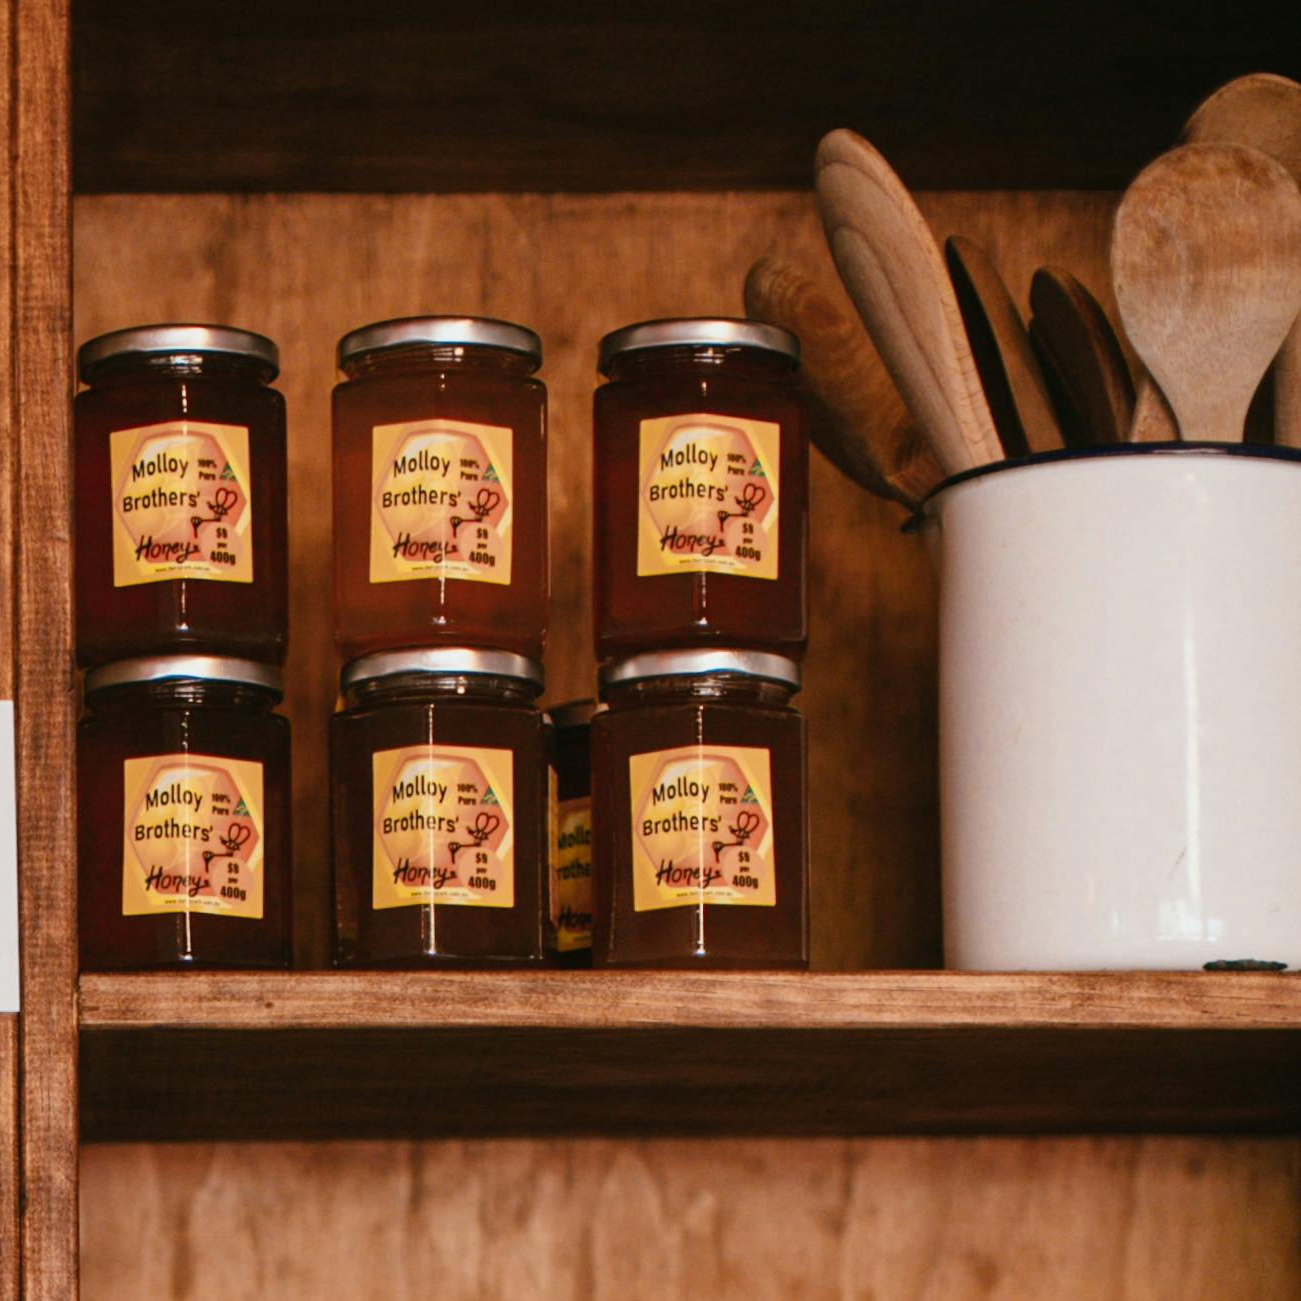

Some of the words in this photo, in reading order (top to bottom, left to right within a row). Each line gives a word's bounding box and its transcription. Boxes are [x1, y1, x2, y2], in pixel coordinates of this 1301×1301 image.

[132, 453, 189, 482] Molloy
[394, 450, 450, 478] Molloy
[661, 443, 718, 471] Molloy
[135, 535, 200, 563] Honey
[393, 531, 457, 563] Honey
[660, 525, 725, 557] Honey
[146, 784, 202, 812] Molloy
[393, 775, 447, 804] Molloy
[653, 776, 709, 806] Molloy
[146, 865, 211, 897] Honey
[394, 857, 457, 889] Honey
[468, 877, 495, 891] 400g
[656, 860, 721, 889] Honey
